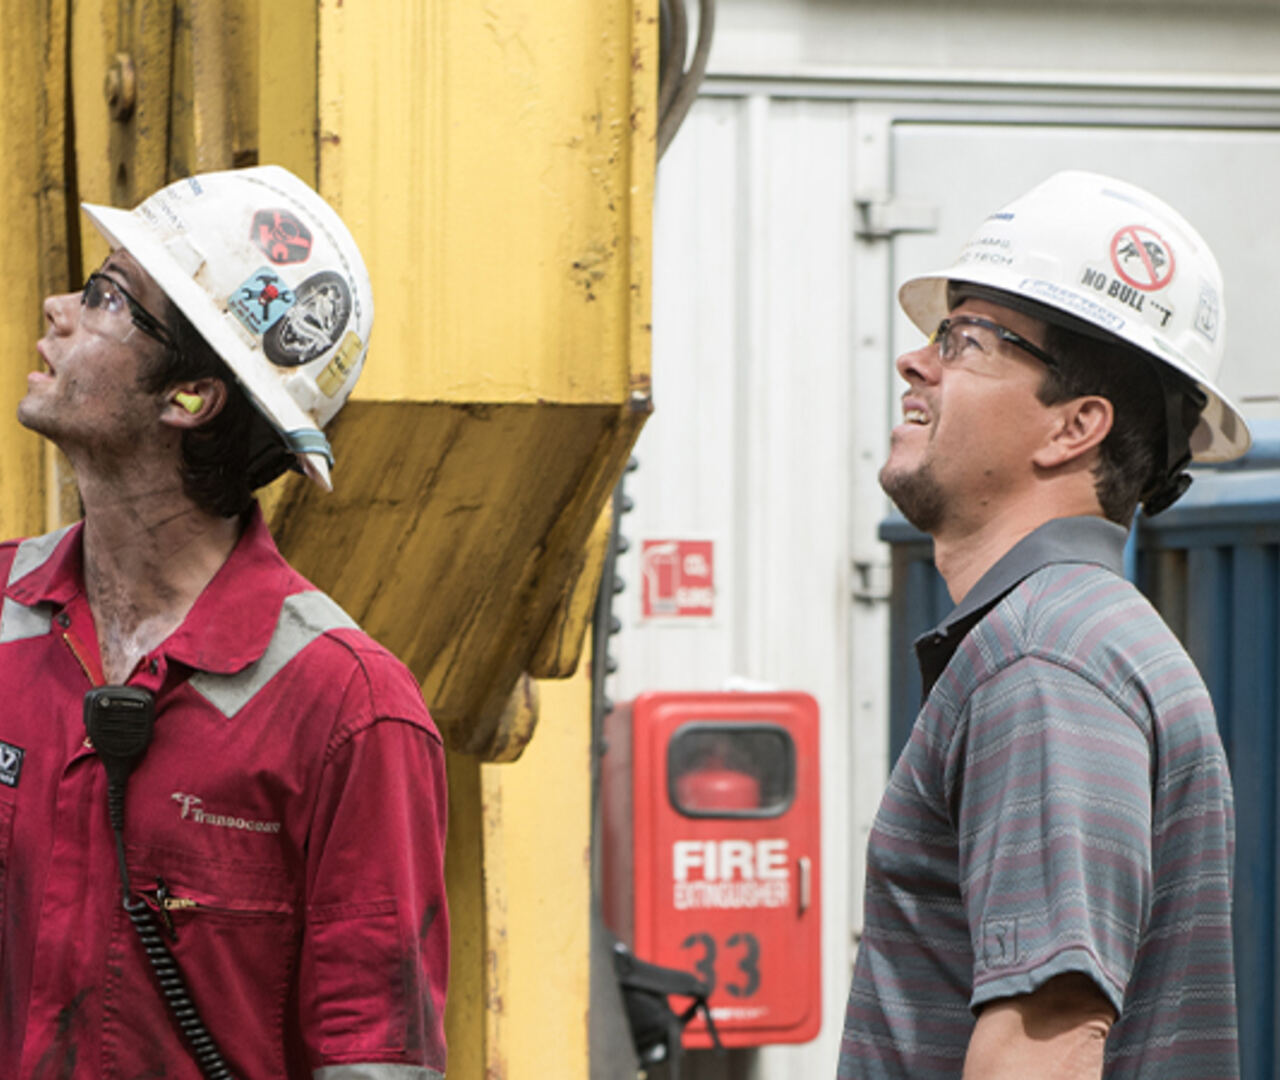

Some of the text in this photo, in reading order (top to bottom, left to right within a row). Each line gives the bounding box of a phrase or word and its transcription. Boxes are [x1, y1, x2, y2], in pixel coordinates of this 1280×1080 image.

[1081, 267, 1108, 291] NO
[1107, 280, 1145, 313] BULL
[192, 808, 281, 833] Transocean
[673, 840, 789, 881] FIRE
[673, 880, 789, 910] EXTINGUISHER
[682, 932, 762, 998] 33
